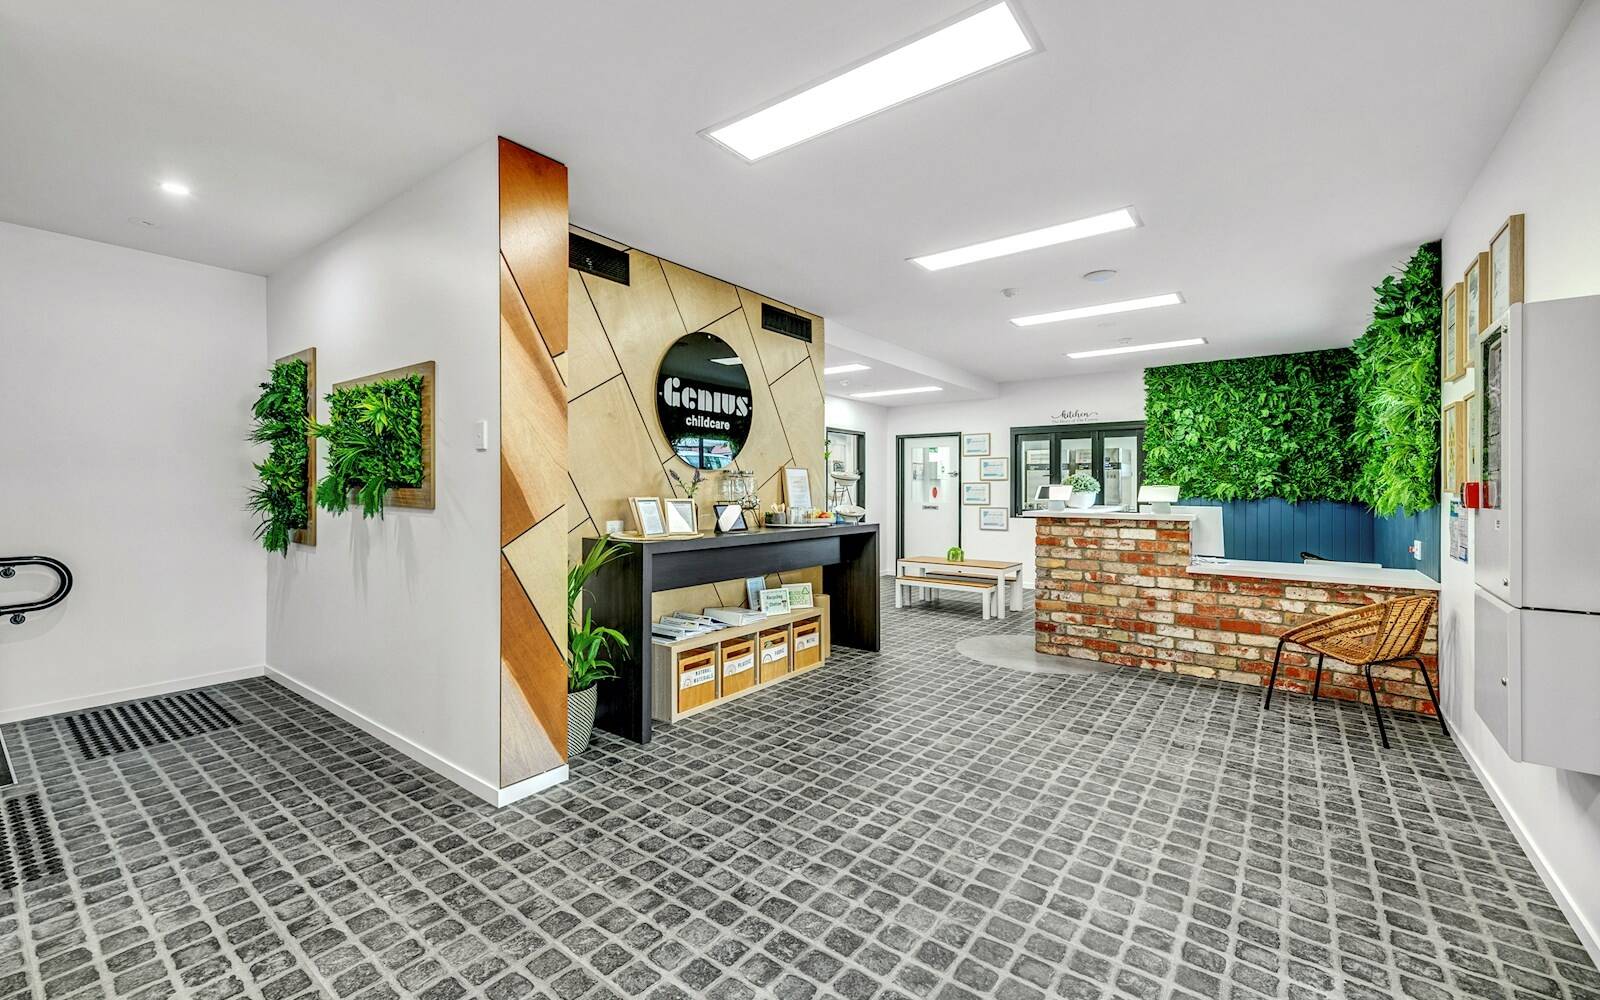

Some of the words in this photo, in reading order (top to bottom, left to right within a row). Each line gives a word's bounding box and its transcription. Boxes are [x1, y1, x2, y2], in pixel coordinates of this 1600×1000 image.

[663, 377, 749, 417] Genius
[685, 414, 730, 430] childcare
[1051, 409, 1098, 419] kitchen
